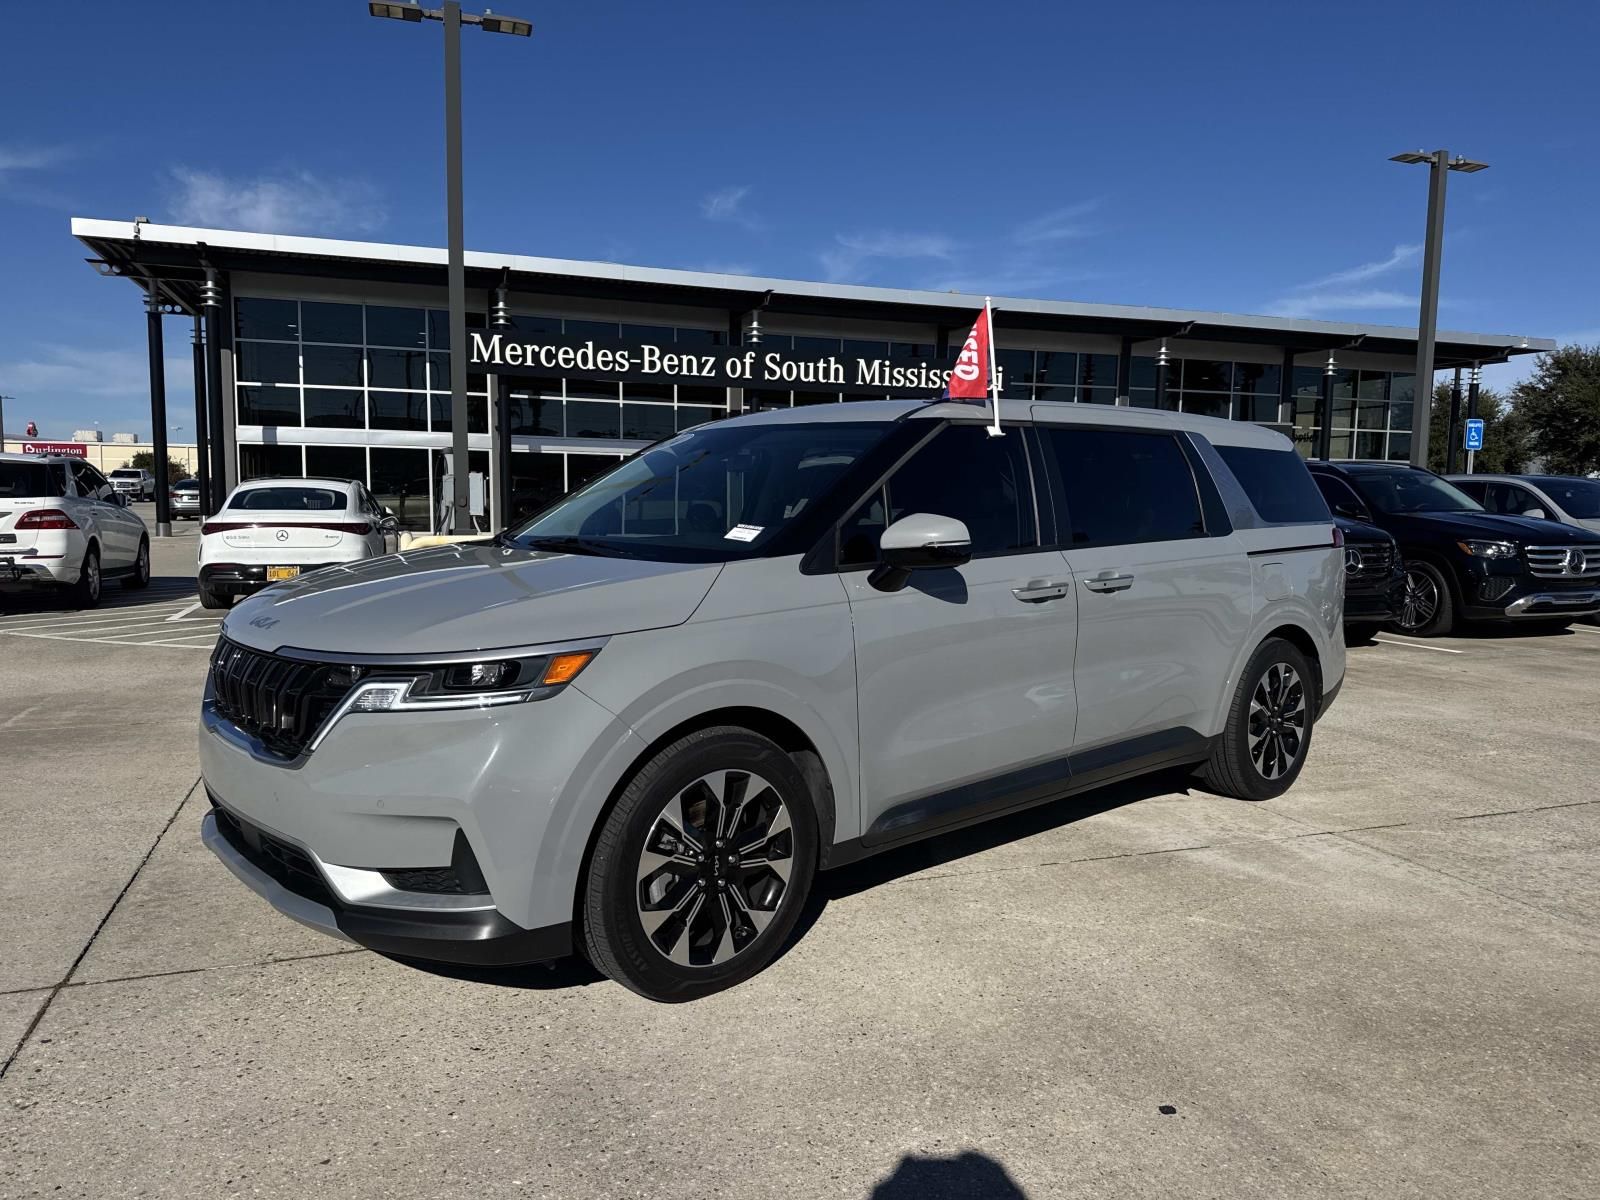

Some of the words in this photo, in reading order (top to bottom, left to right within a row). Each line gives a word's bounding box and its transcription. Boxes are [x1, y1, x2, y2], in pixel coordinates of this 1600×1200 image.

[470, 332, 716, 377] Mercedes-Benz
[725, 352, 756, 379] of
[764, 352, 846, 384] South
[855, 358, 1004, 392] Mississi
[25, 444, 83, 456] Burlington
